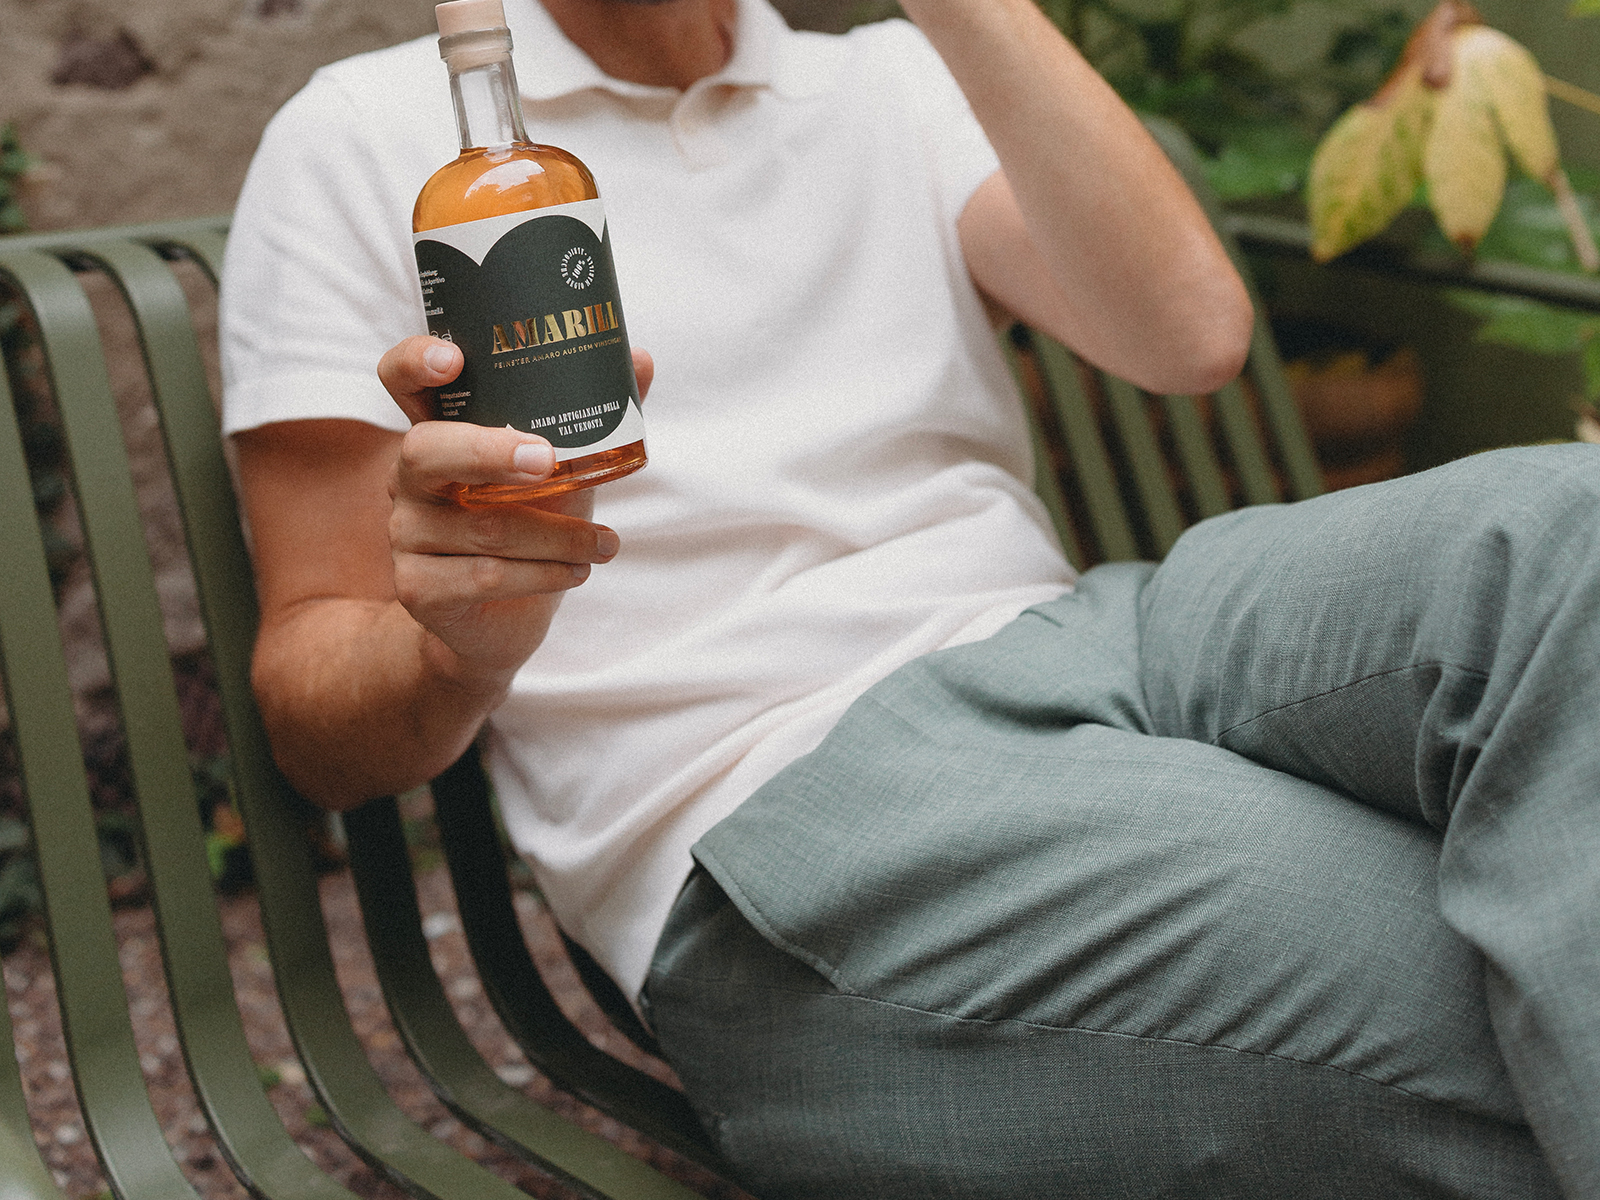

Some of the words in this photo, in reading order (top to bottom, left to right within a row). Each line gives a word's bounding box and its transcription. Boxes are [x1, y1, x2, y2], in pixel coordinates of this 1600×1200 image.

[565, 277, 585, 290] REGIO
[584, 255, 595, 287] MARILLE
[572, 259, 586, 279] 100%
[491, 301, 619, 355] AMARILL
[494, 356, 531, 369] FEINSTER
[532, 351, 561, 363] AMARO
[562, 346, 577, 356] AUS
[578, 343, 594, 353] DEM
[530, 415, 557, 430] AMARO
[558, 404, 602, 424] ARTIGIANALE
[602, 400, 620, 413] DELLA
[558, 425, 573, 436] VAL
[573, 418, 604, 433] VENOSTA
